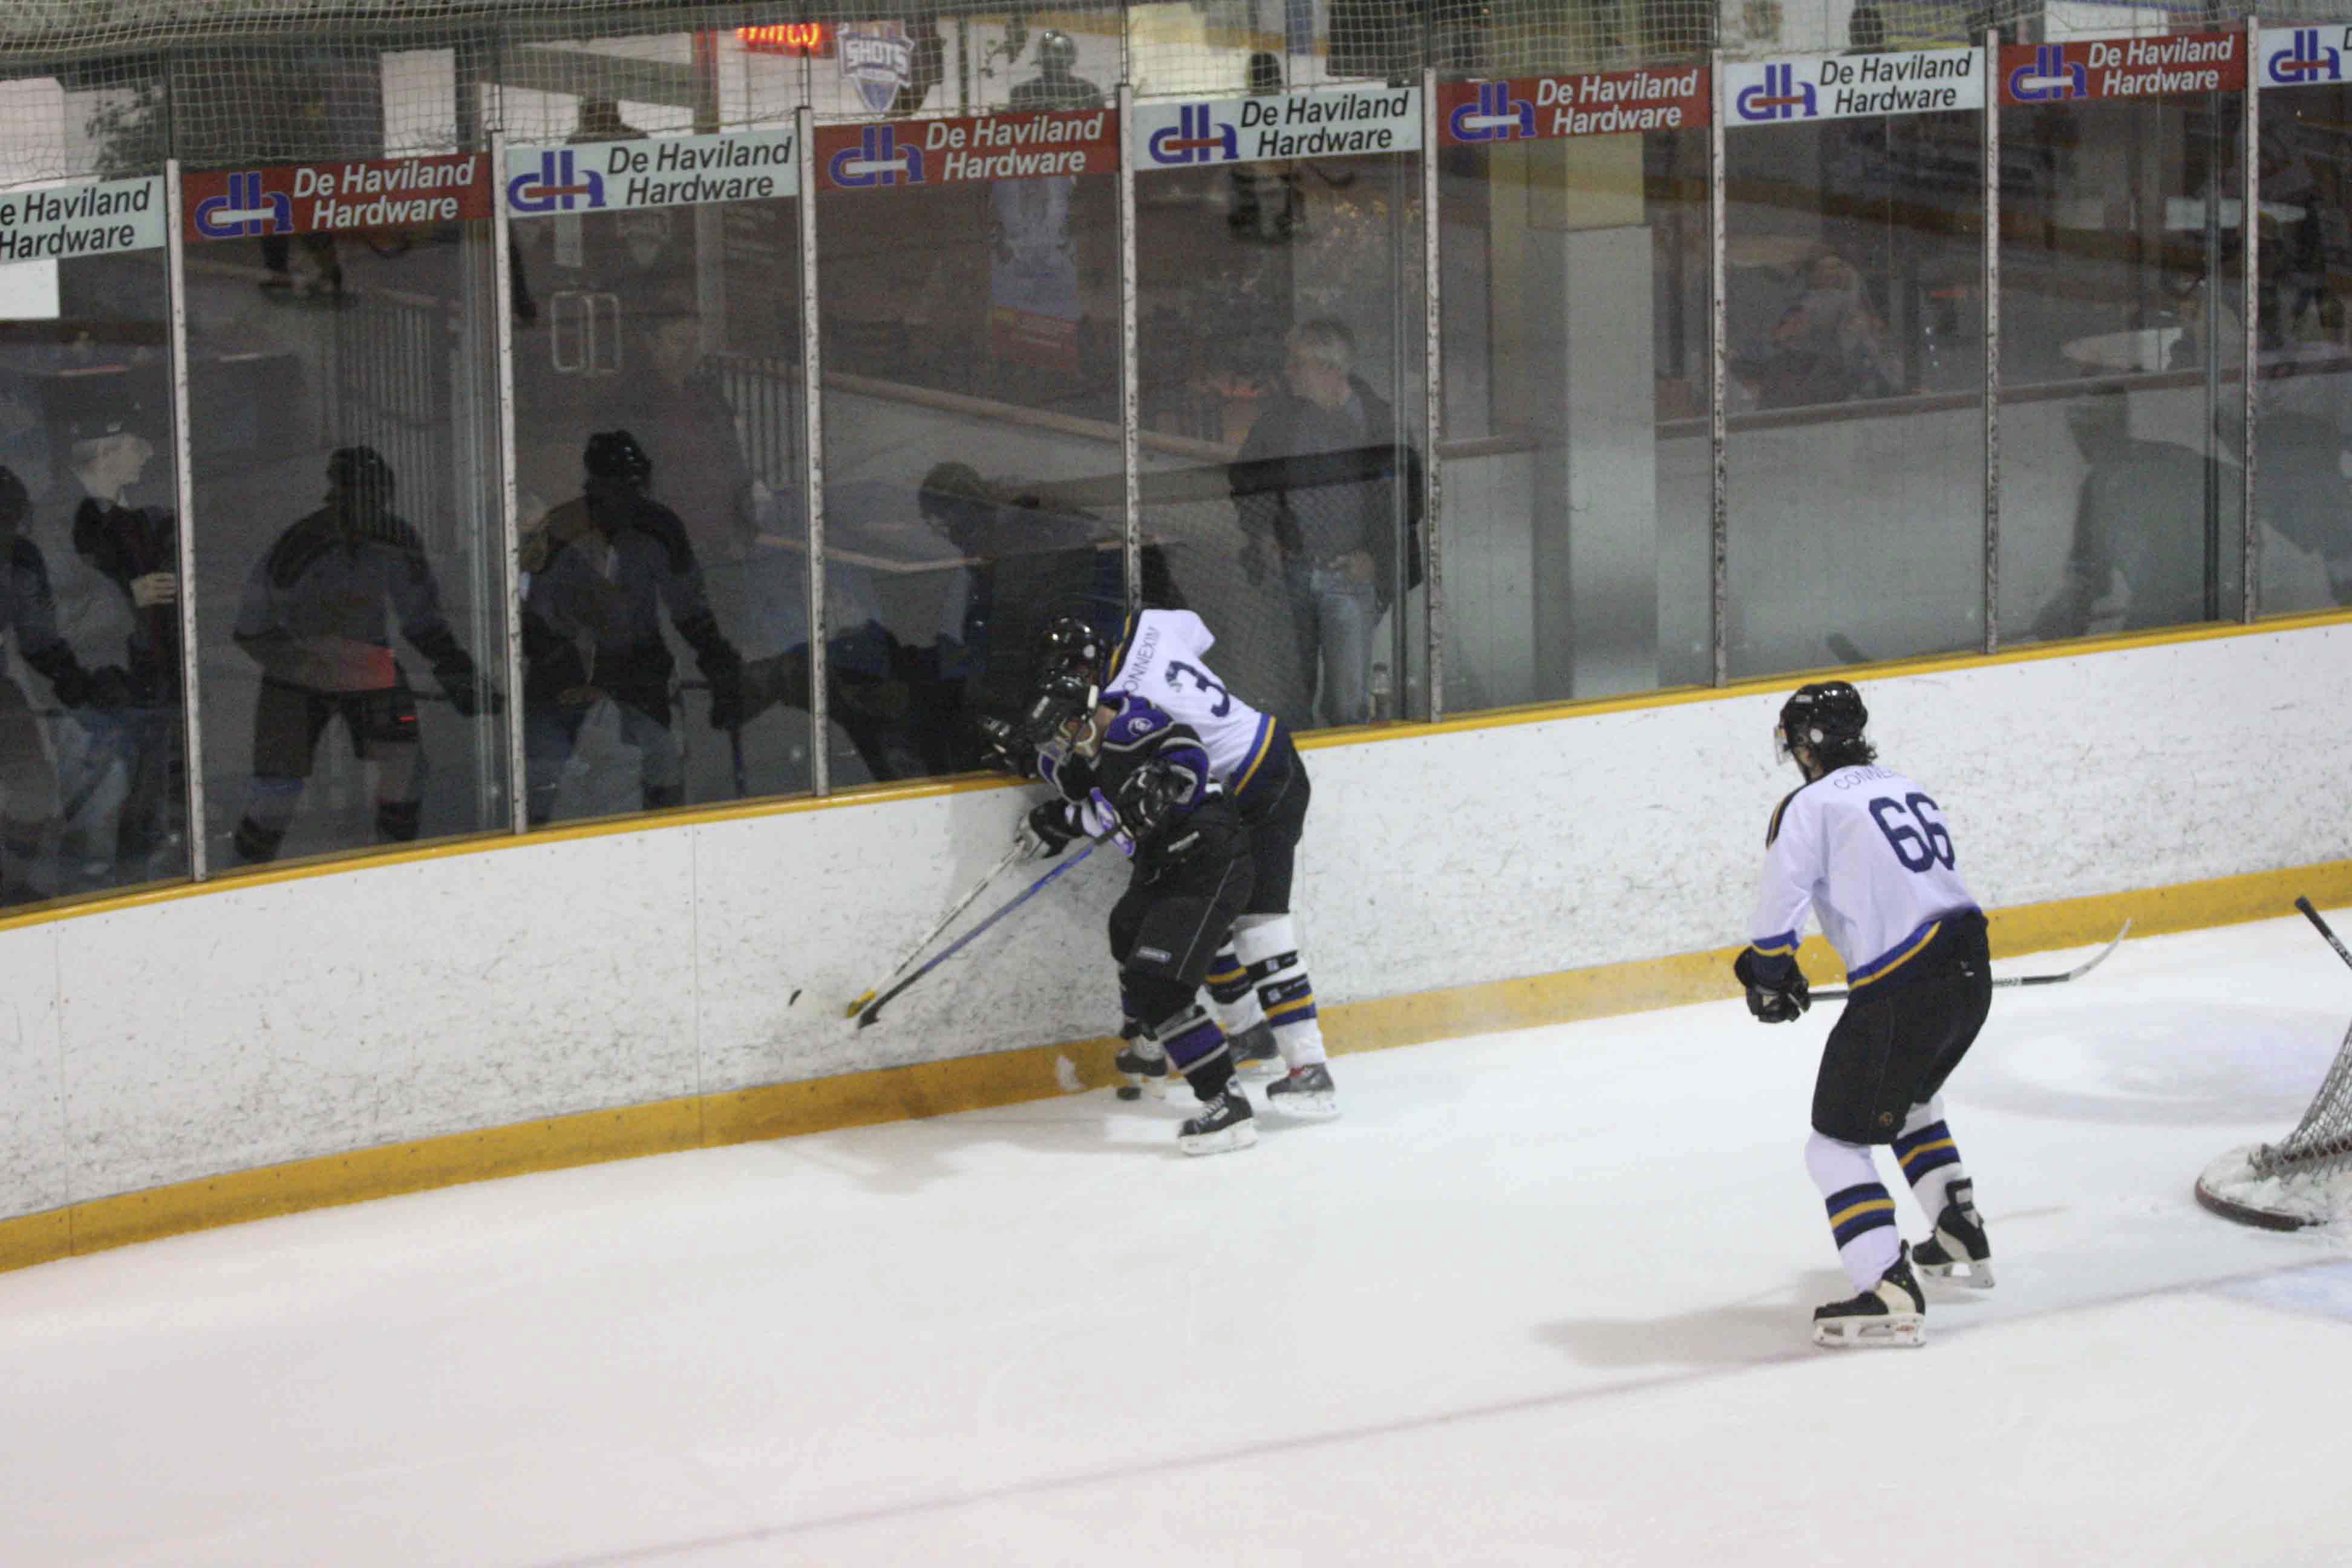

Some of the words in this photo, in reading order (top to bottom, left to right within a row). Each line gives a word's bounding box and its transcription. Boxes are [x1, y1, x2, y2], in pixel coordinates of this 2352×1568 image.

[1820, 60, 1854, 87] De
[1860, 51, 1972, 83] Haviland
[2088, 42, 2123, 69] De
[2127, 34, 2235, 66] Haviland
[1536, 79, 1573, 106] De
[1579, 69, 1698, 103] Haviland
[2102, 65, 2220, 97] Hardware
[1241, 101, 1278, 128] De
[1285, 90, 1409, 125] Haviland
[1835, 83, 1957, 115] Hardware
[926, 121, 966, 151] De
[972, 112, 1104, 147] Haviland
[1552, 105, 1682, 136] Hardware
[607, 146, 648, 175] De
[656, 137, 792, 172] Haviland
[1257, 126, 1392, 157] Hardware
[294, 168, 335, 198] De
[342, 156, 475, 195] Haviland
[943, 149, 1086, 181] Hardware
[0, 203, 16, 226] e
[24, 181, 151, 223] Haviland
[626, 172, 774, 206] Hardware
[312, 197, 458, 230] Hardware
[0, 224, 135, 259] Hardware
[1165, 660, 1230, 717] 3
[1869, 792, 1955, 873] 66
